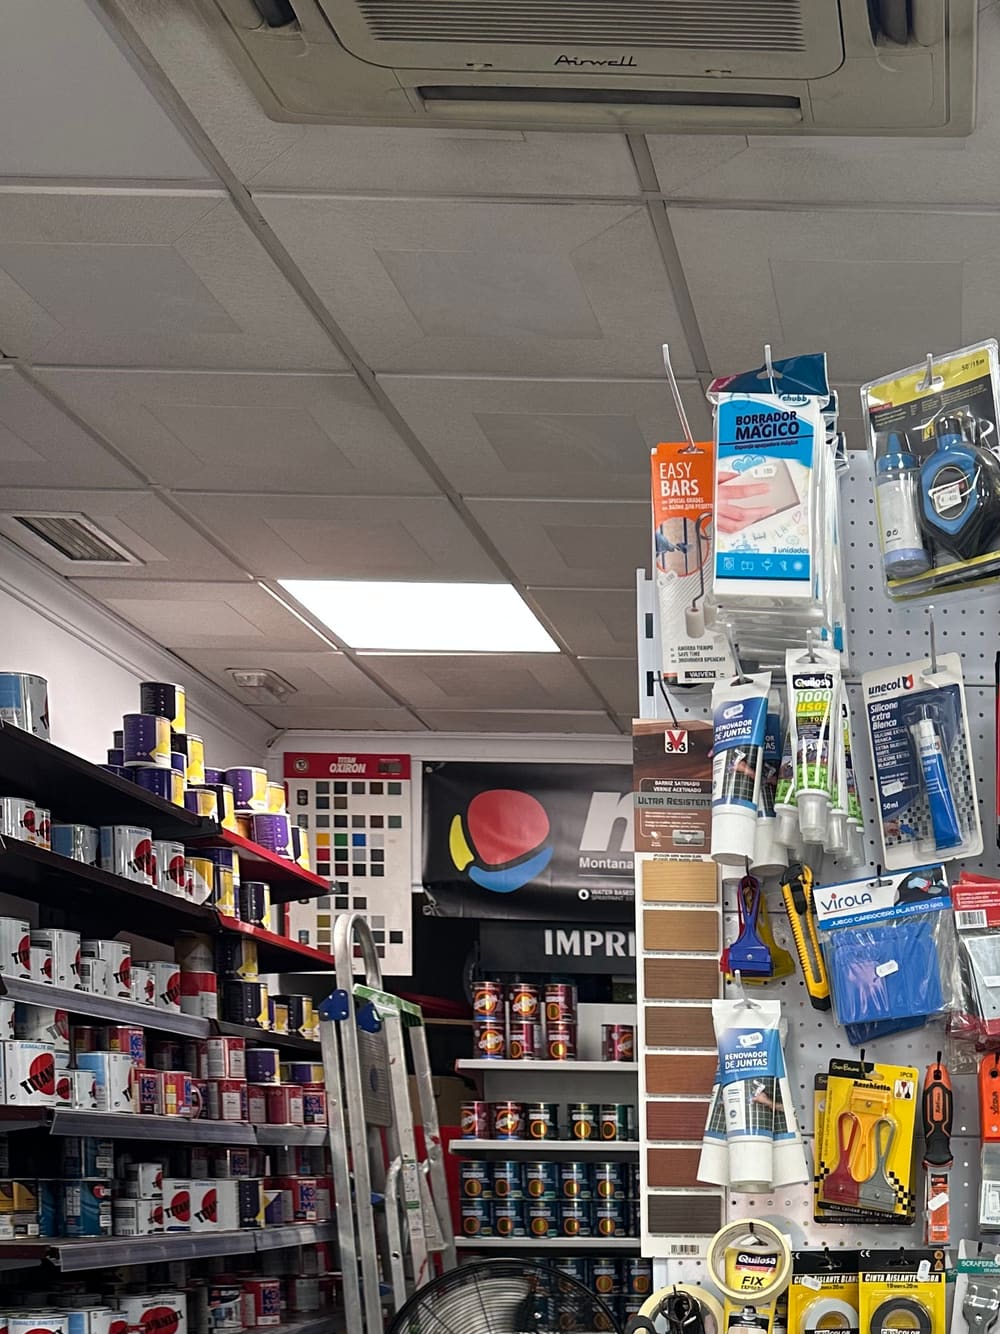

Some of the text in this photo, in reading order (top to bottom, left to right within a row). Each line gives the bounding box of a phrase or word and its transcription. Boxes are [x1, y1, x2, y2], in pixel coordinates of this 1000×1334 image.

[553, 53, 638, 68] Airwell
[735, 410, 797, 426] BORRADOR
[735, 422, 799, 441] MÁGICO
[659, 462, 692, 479] EASY
[661, 479, 699, 496] BARS
[868, 680, 901, 697] unecol
[797, 691, 831, 702] 1000
[871, 711, 891, 722] extra
[872, 719, 898, 732] Blanca
[722, 726, 752, 738] JUNTAS
[329, 763, 366, 773] OXIRON
[579, 857, 634, 869] Montana
[829, 904, 929, 927] JUEGO CARROCERO PLASTICO
[725, 1051, 768, 1060] RENOVADOR
[725, 1058, 768, 1069] DE JUNTAS
[738, 1254, 776, 1266] Quilosa
[742, 1275, 765, 1286] FIX
